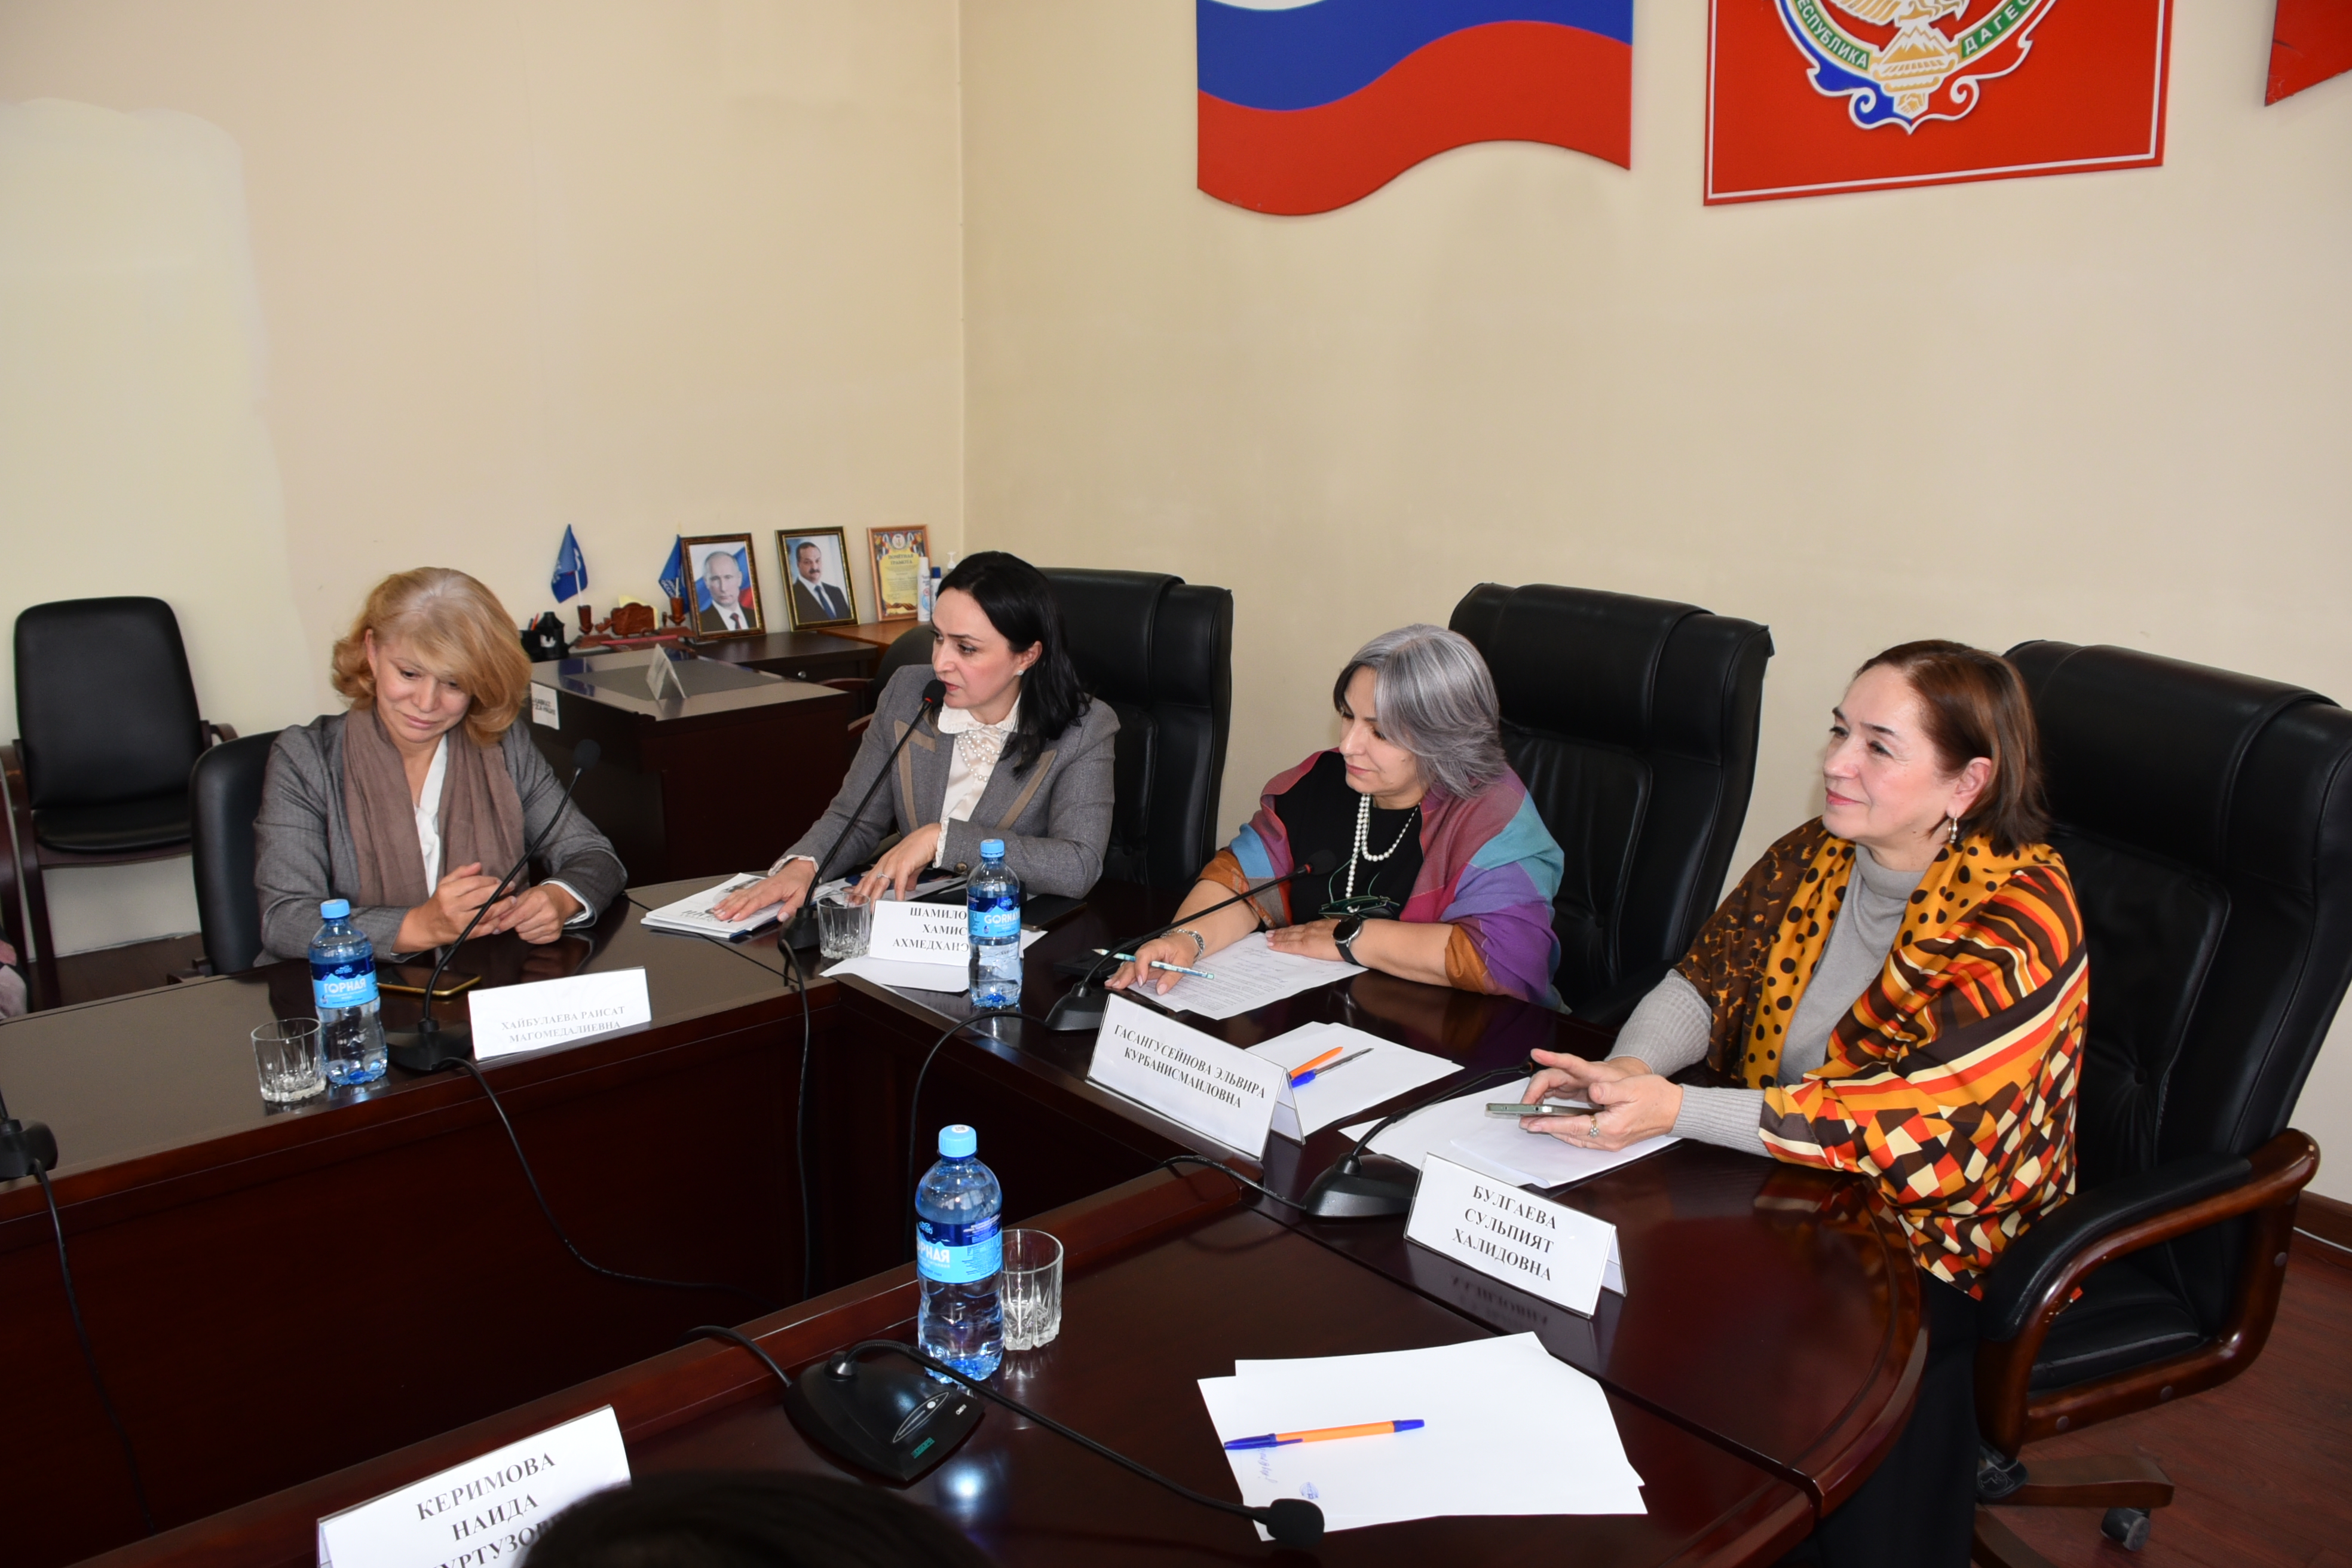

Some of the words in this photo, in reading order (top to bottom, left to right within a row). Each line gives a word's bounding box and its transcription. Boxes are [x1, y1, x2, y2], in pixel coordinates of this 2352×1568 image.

[1797, 0, 1867, 68] ЕСПУБЛИКА
[910, 907, 967, 920] ШАМИЛО
[923, 924, 967, 936] ХАМИС
[893, 938, 969, 952] АХМЕДХАНО
[323, 978, 367, 994] ГОРНАЯ
[501, 1014, 578, 1030] ХАЙБУЛАЕВА
[581, 1006, 625, 1019] РАИСАТ
[510, 1021, 621, 1043] МАГОМЕДАЛИЕВНА
[1114, 1024, 1211, 1075] ГАСАНГУСЕЙНОВА
[1214, 1067, 1265, 1098] ЭЛЬВИРА
[1125, 1047, 1241, 1108] КУРБАНИСМАИЛОВНА
[1472, 1185, 1556, 1230] БУЛГАЕВА
[917, 1236, 950, 1263] ОРНАЯ
[1465, 1208, 1554, 1254] СУЛЬПИЯТ
[1452, 1228, 1551, 1281] ХАЛИДОВНА
[415, 1452, 556, 1521] КЕРИМОВА
[450, 1493, 539, 1542] НАИДА
[431, 1521, 550, 1568] УРТУЗО
